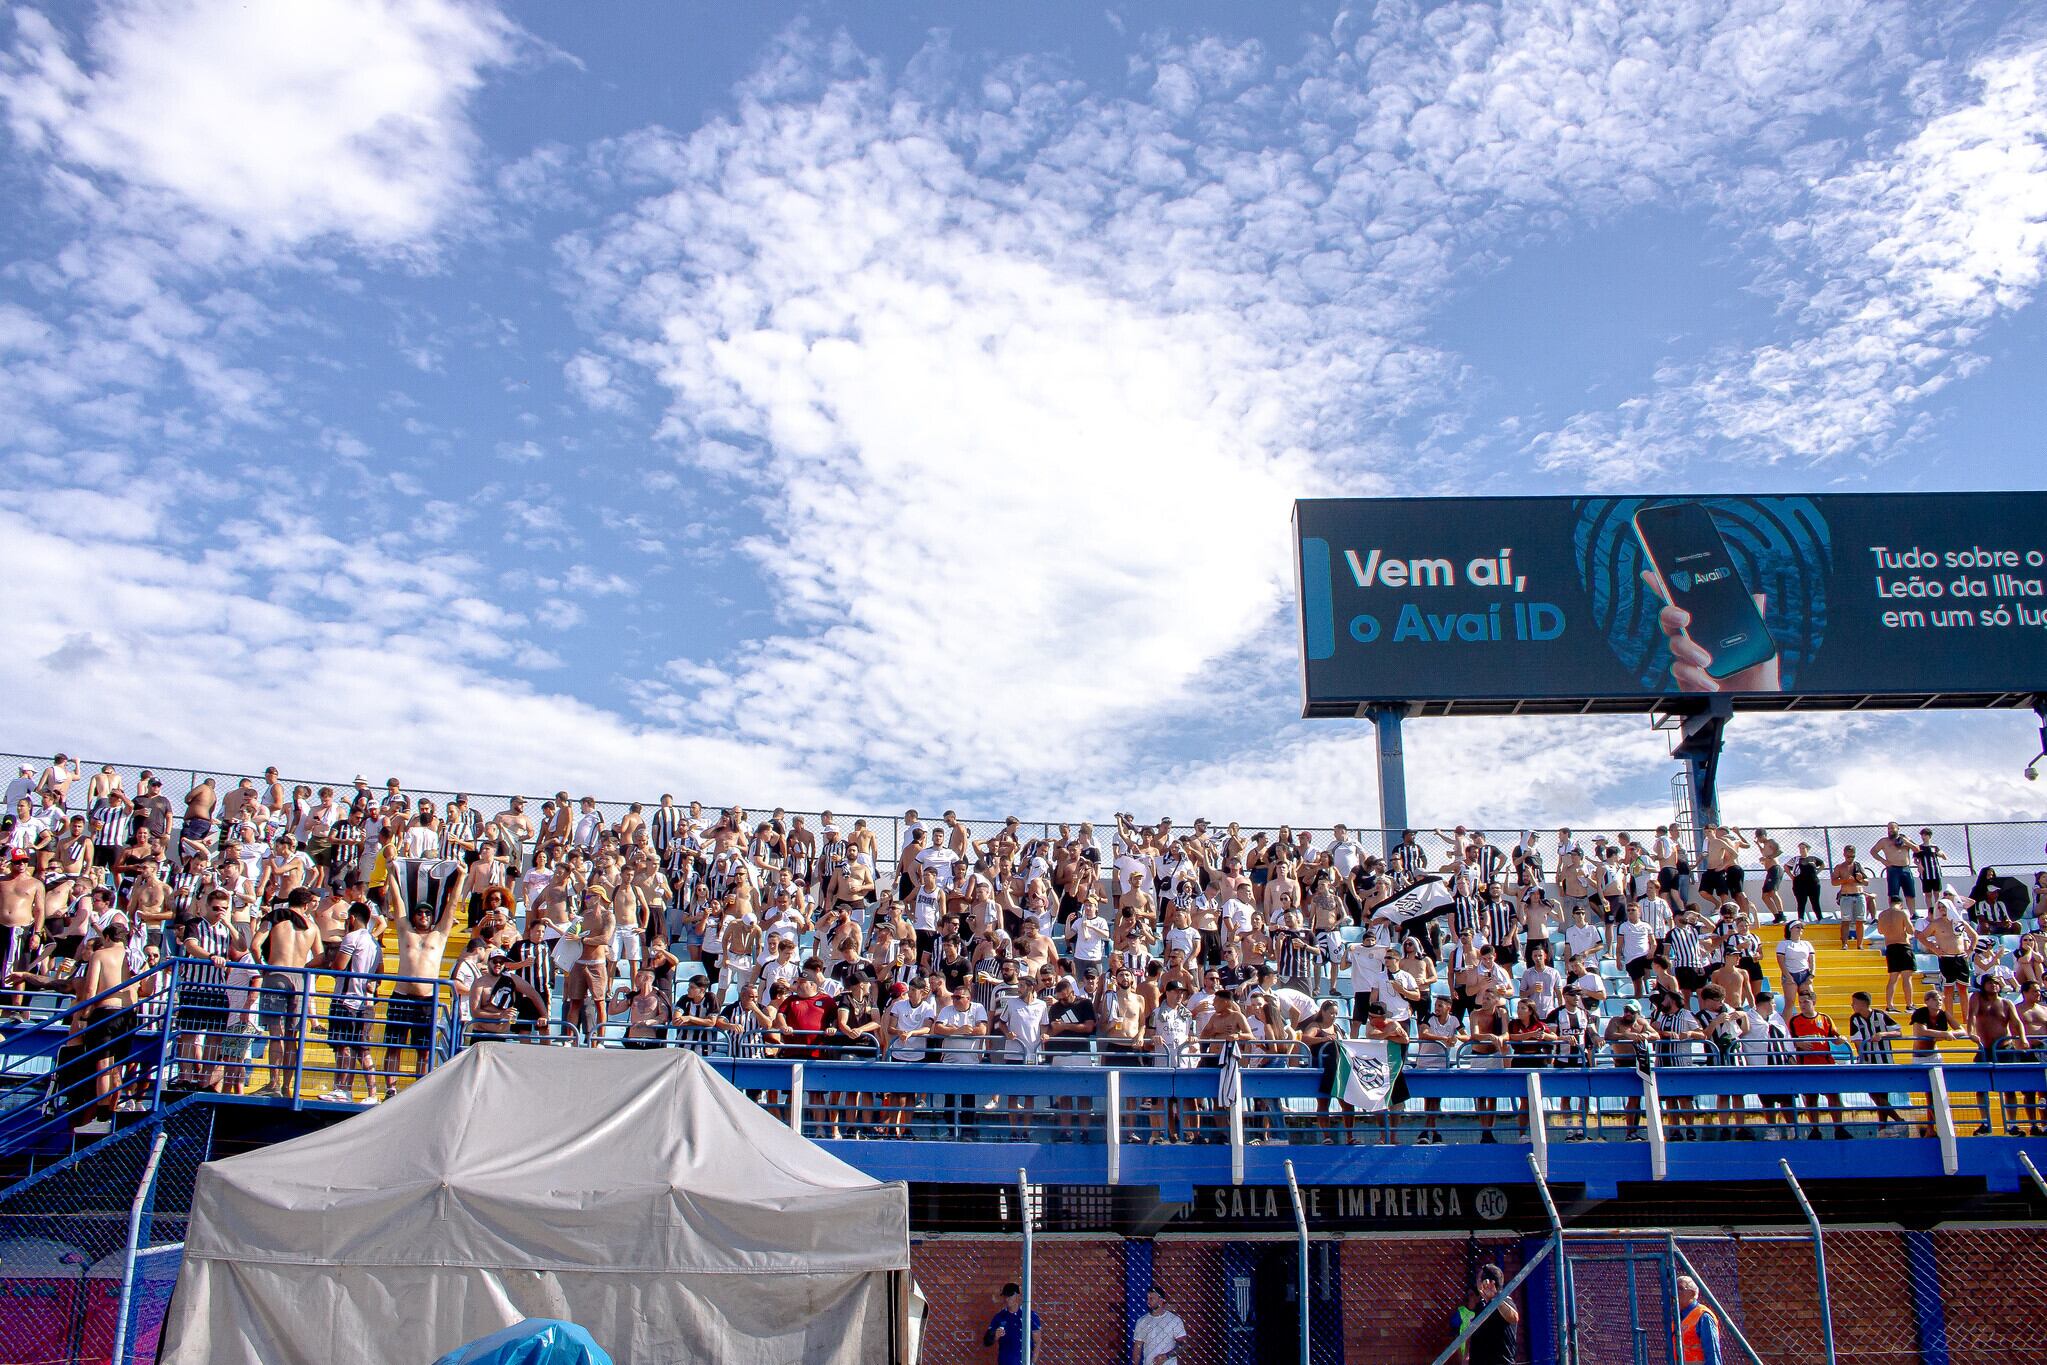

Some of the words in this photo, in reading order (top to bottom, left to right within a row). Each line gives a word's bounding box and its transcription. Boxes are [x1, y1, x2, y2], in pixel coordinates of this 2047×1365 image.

[1344, 549, 1455, 588] Vem
[1466, 548, 1528, 593] aí,
[1870, 546, 1940, 569] Tudo
[1945, 545, 2019, 568] sobre
[2026, 550, 2044, 567] o
[1876, 575, 1945, 598] Leão
[1950, 575, 1988, 597] da
[1993, 573, 2043, 596] Ilha
[1350, 614, 1382, 643] o
[1392, 602, 1502, 642] Avaí
[1514, 602, 1567, 641] ID
[1882, 610, 1925, 628] em
[1931, 610, 1975, 627] um
[1980, 603, 2012, 627] só
[1215, 1188, 1278, 1218] SALA
[1338, 1187, 1462, 1217] IMPRENSA
